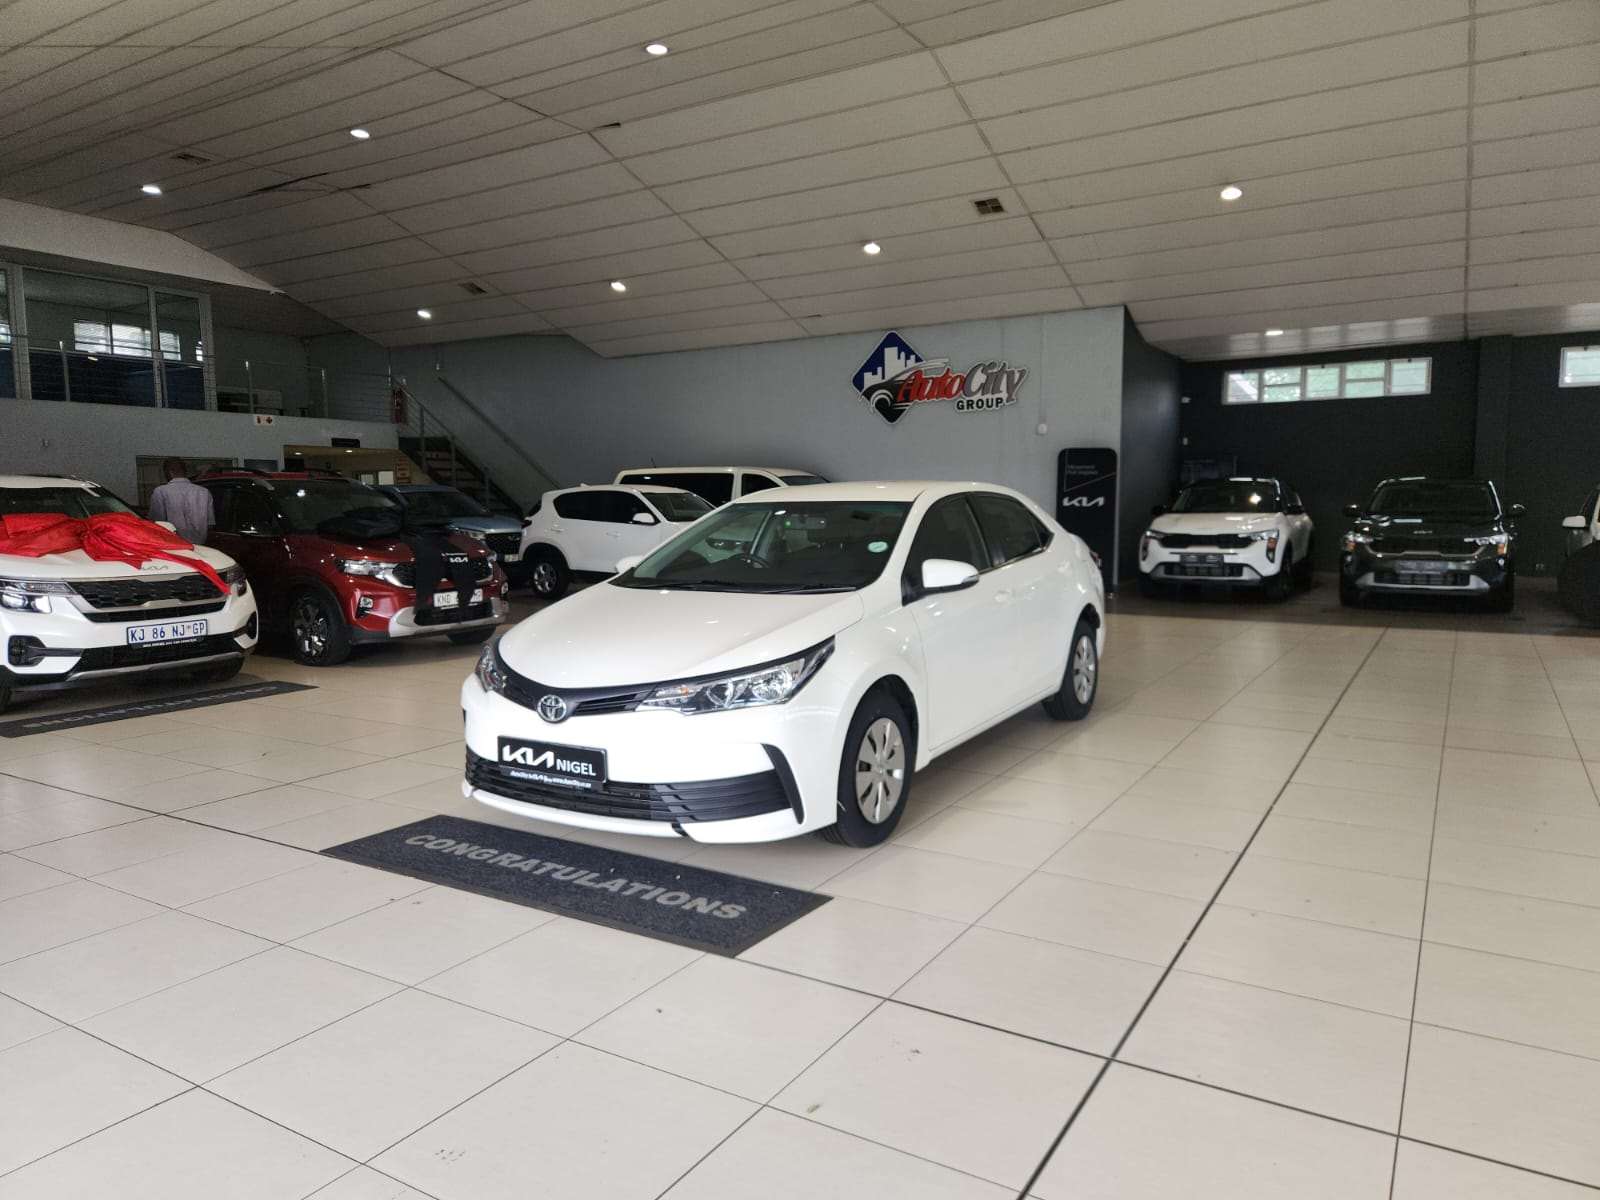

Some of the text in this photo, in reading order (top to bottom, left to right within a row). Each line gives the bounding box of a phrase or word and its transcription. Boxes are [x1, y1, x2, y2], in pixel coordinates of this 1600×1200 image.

[896, 360, 1027, 403] AutoCity
[956, 397, 1004, 411] GROUP
[1062, 496, 1105, 507] KIA
[130, 622, 205, 641] KJ 86 NJ GP
[502, 744, 597, 777] KIA NIGEL
[404, 833, 748, 920] CONGRATULATIONS
